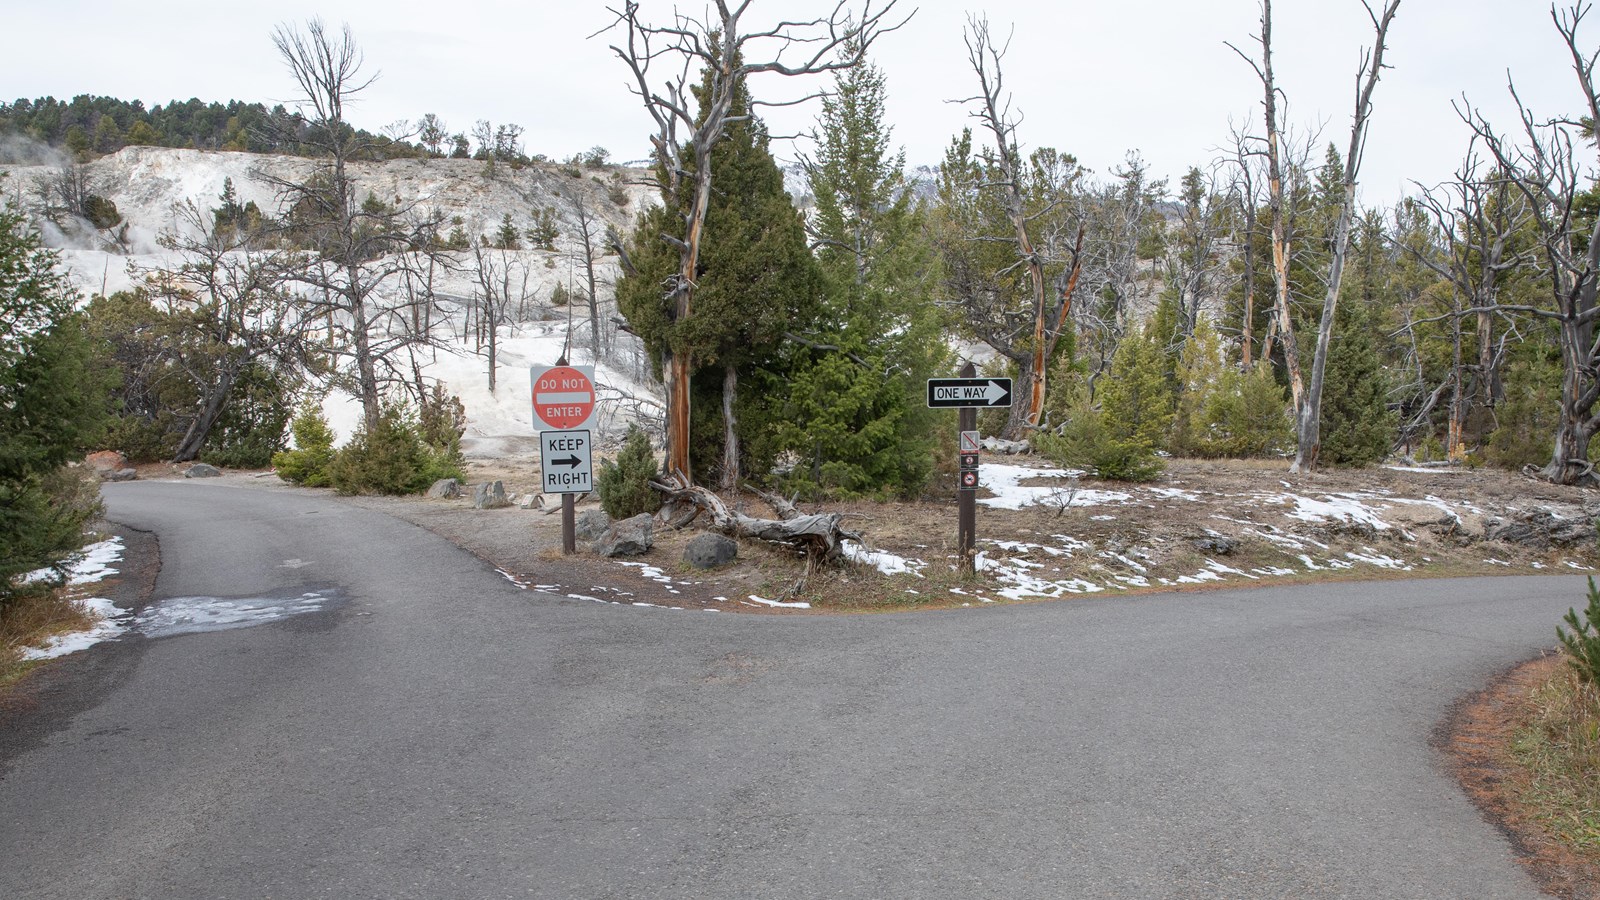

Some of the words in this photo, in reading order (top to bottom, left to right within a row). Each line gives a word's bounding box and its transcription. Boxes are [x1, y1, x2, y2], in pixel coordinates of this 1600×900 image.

[541, 379, 557, 390] DO
[562, 378, 585, 389] NOT
[937, 387, 960, 399] ONE
[963, 387, 987, 399] WAY
[546, 406, 582, 418] ENTER
[549, 438, 584, 451] KEEP
[548, 472, 588, 485] RIGHT
